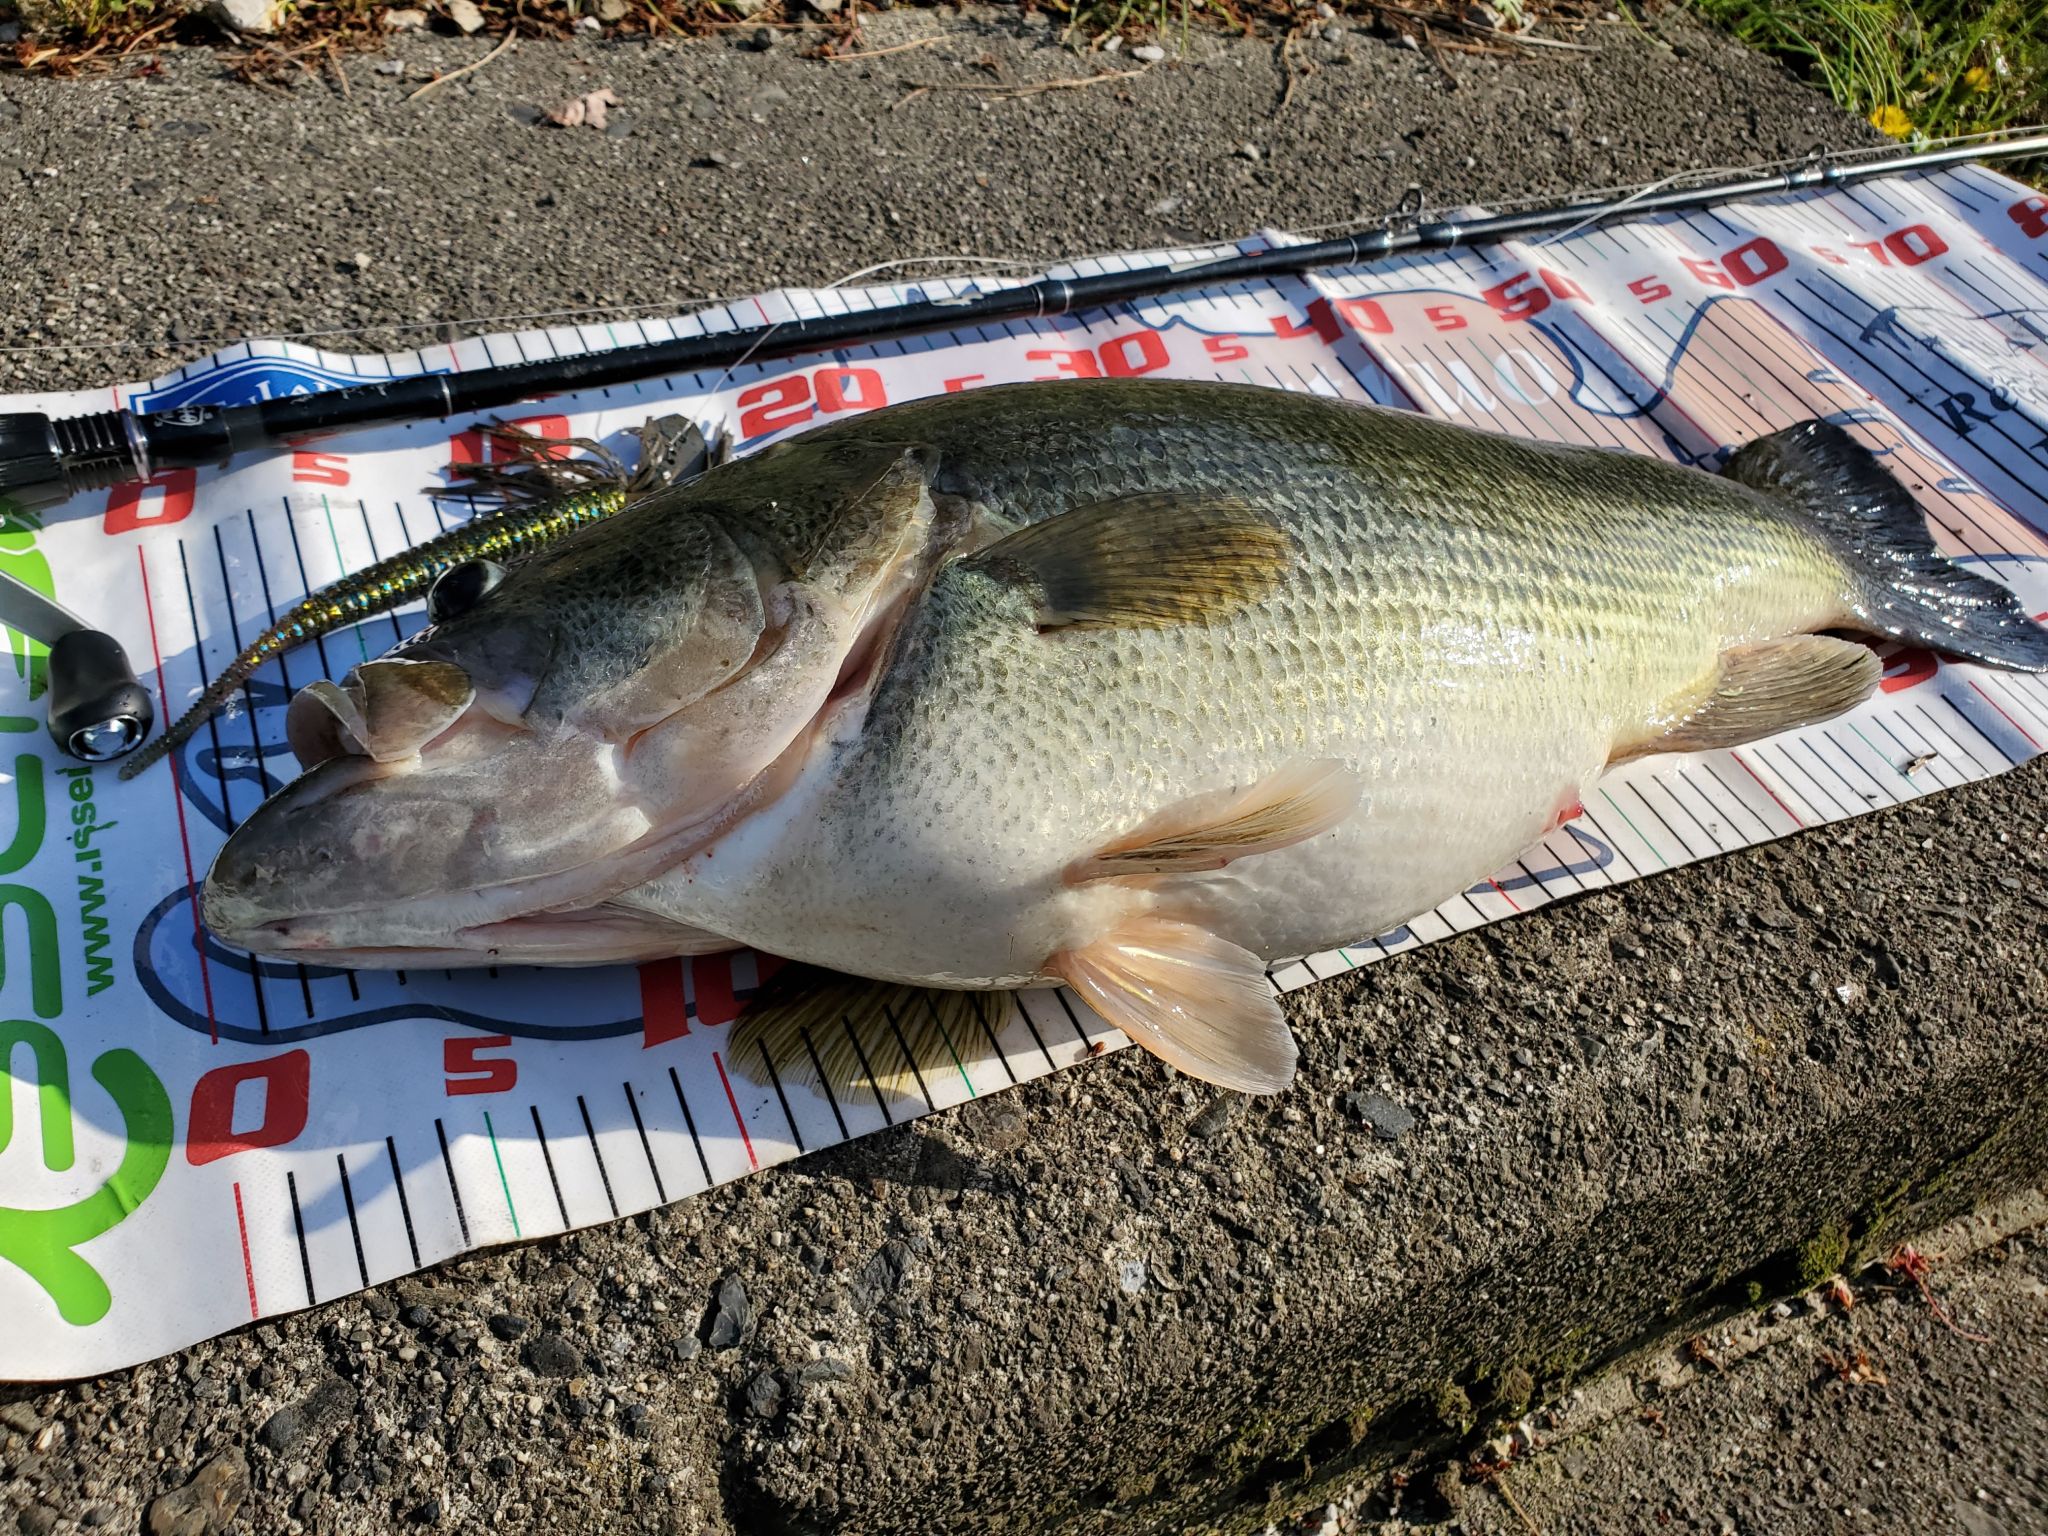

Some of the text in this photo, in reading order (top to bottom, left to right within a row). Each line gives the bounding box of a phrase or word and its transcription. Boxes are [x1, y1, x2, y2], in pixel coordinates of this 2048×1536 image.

[103, 466, 197, 536] 0
[293, 451, 350, 487] 5
[737, 368, 887, 439] 20
[1026, 329, 1170, 379] 30
[1202, 333, 1249, 363] 5
[1269, 297, 1395, 346] 40
[1424, 305, 1468, 332] 5
[1626, 275, 1673, 304] 5
[1678, 236, 1790, 290] 60
[1846, 224, 1950, 268] 70
[186, 1048, 310, 1167] 0
[443, 1035, 518, 1097] 5
